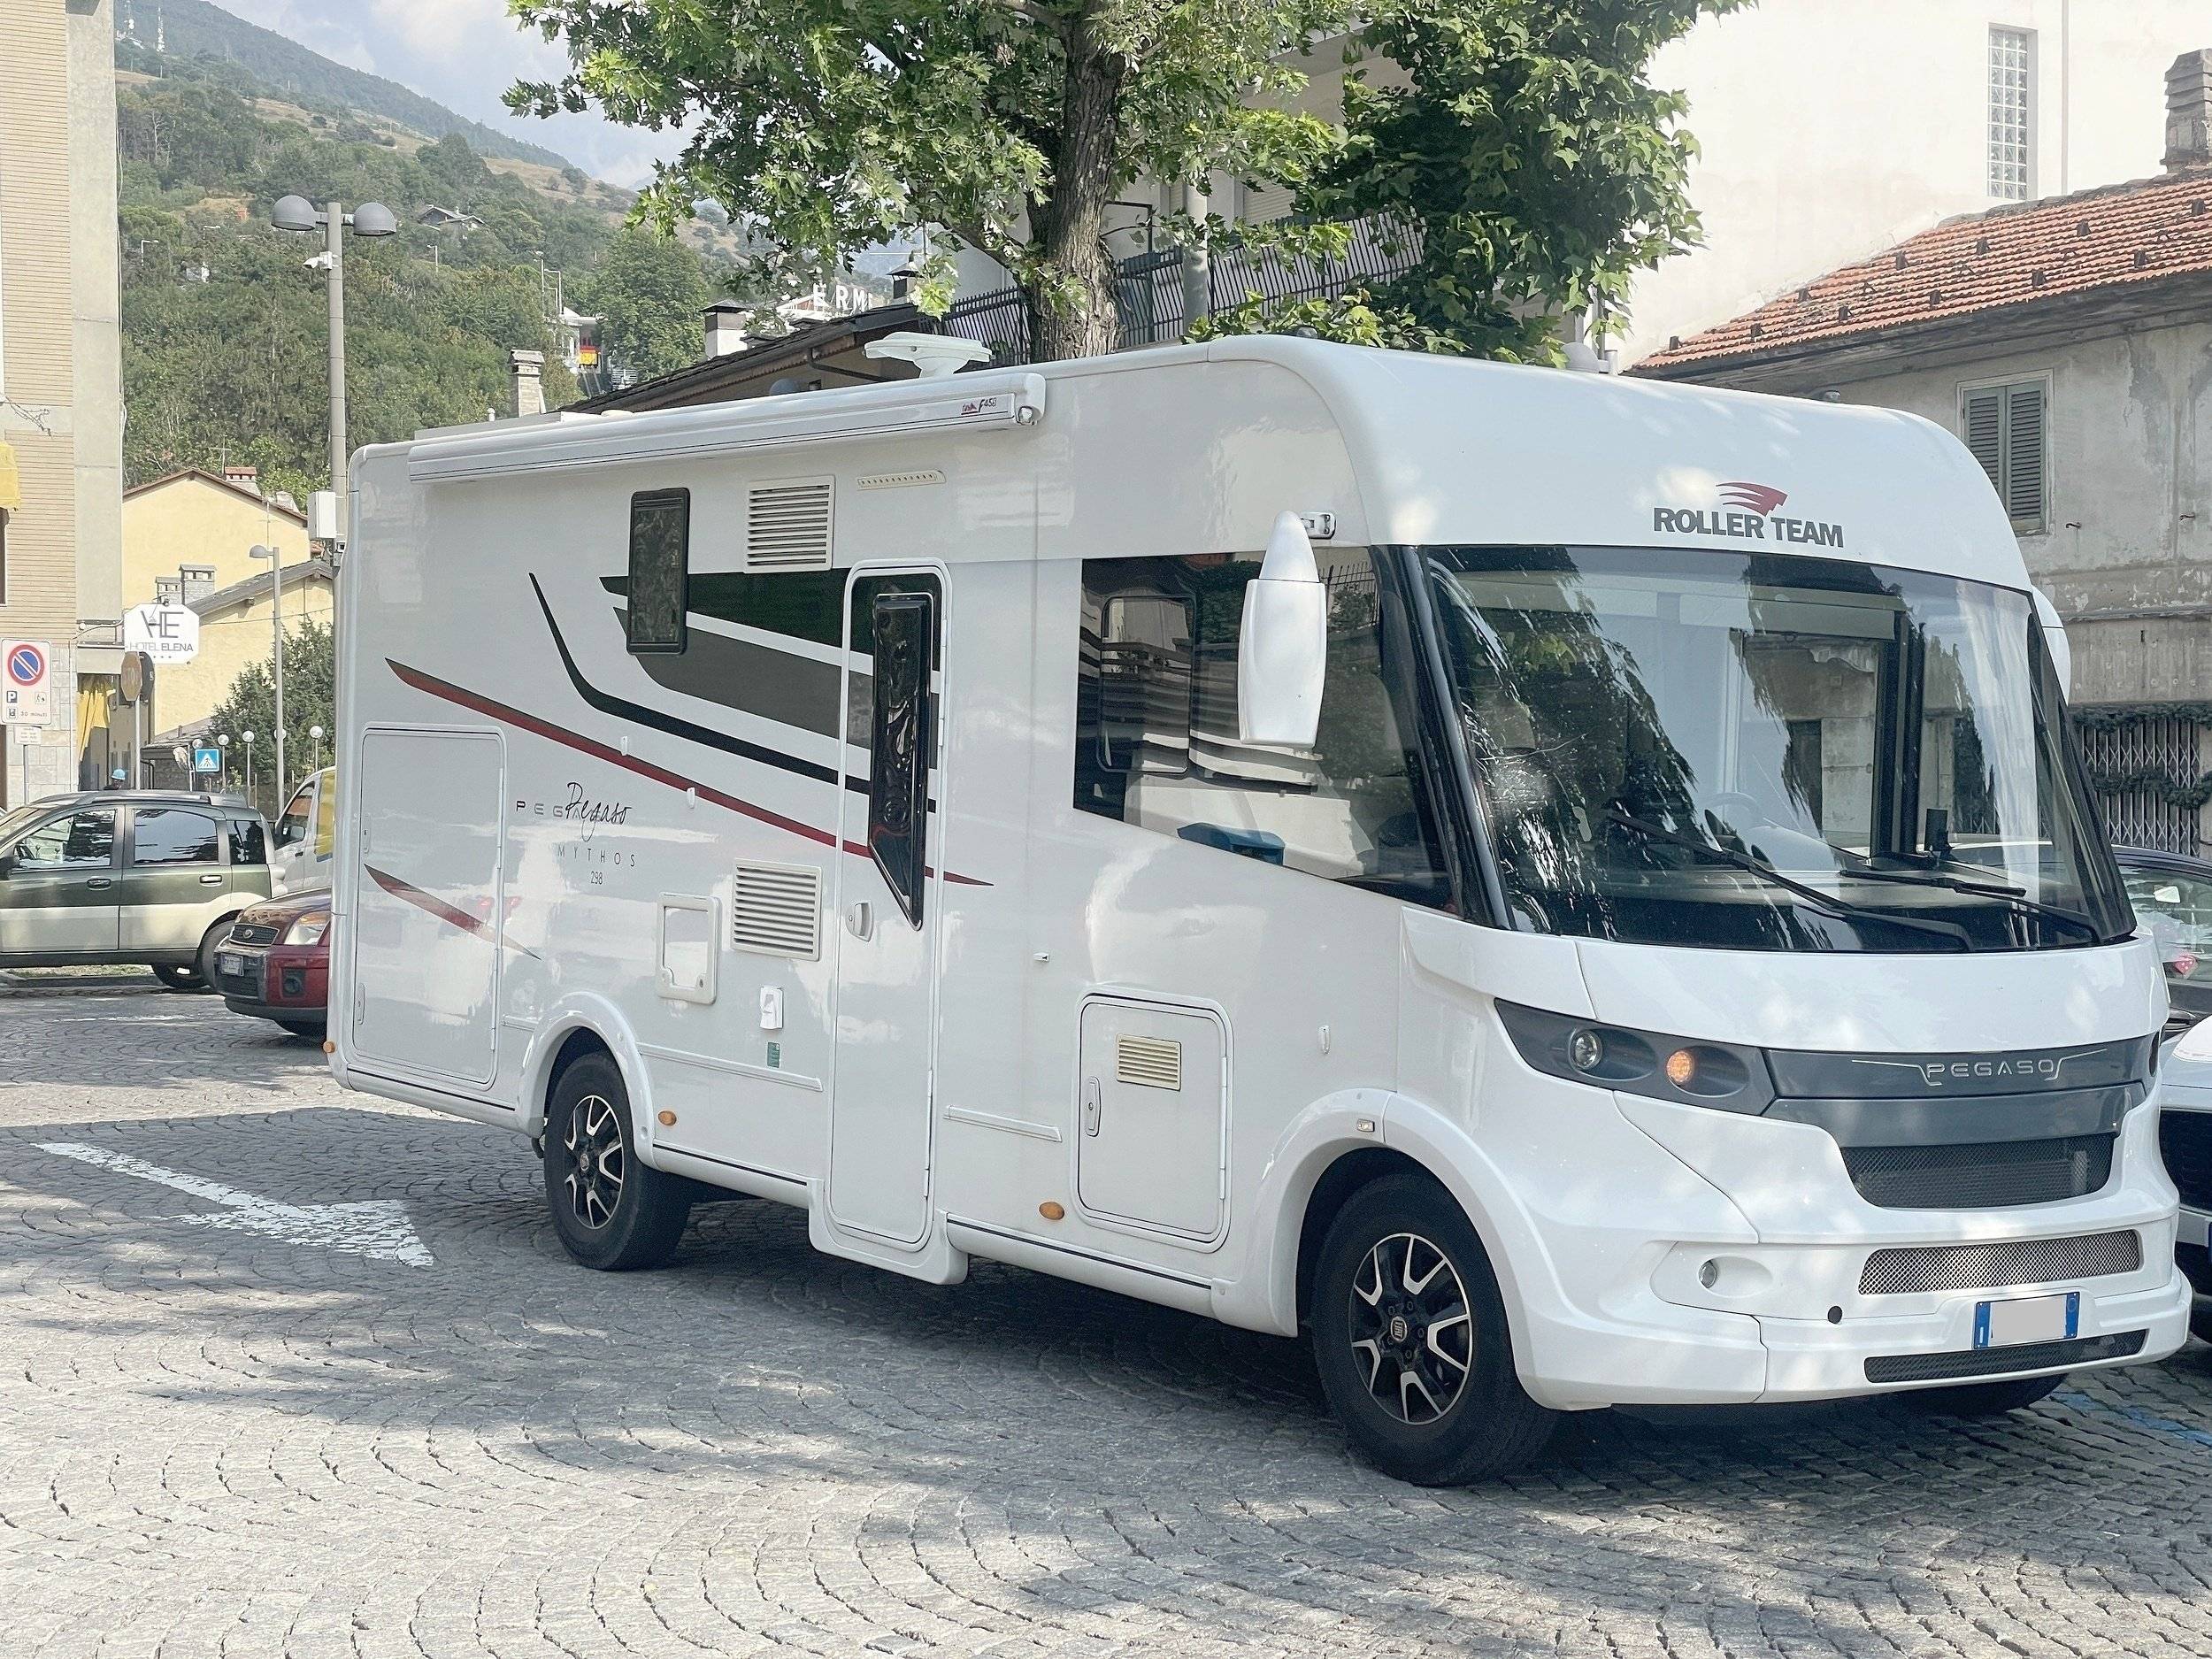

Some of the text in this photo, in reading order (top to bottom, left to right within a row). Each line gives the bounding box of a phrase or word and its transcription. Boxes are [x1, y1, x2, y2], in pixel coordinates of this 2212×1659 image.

[1654, 507, 1844, 548] ROLLER TEAM
[129, 641, 194, 652] HOTEL ELENA
[565, 782, 633, 842] Pegaso
[557, 843, 635, 867] MYTHOS
[590, 871, 603, 886] 298
[1925, 1058, 2054, 1079] PEGASO
